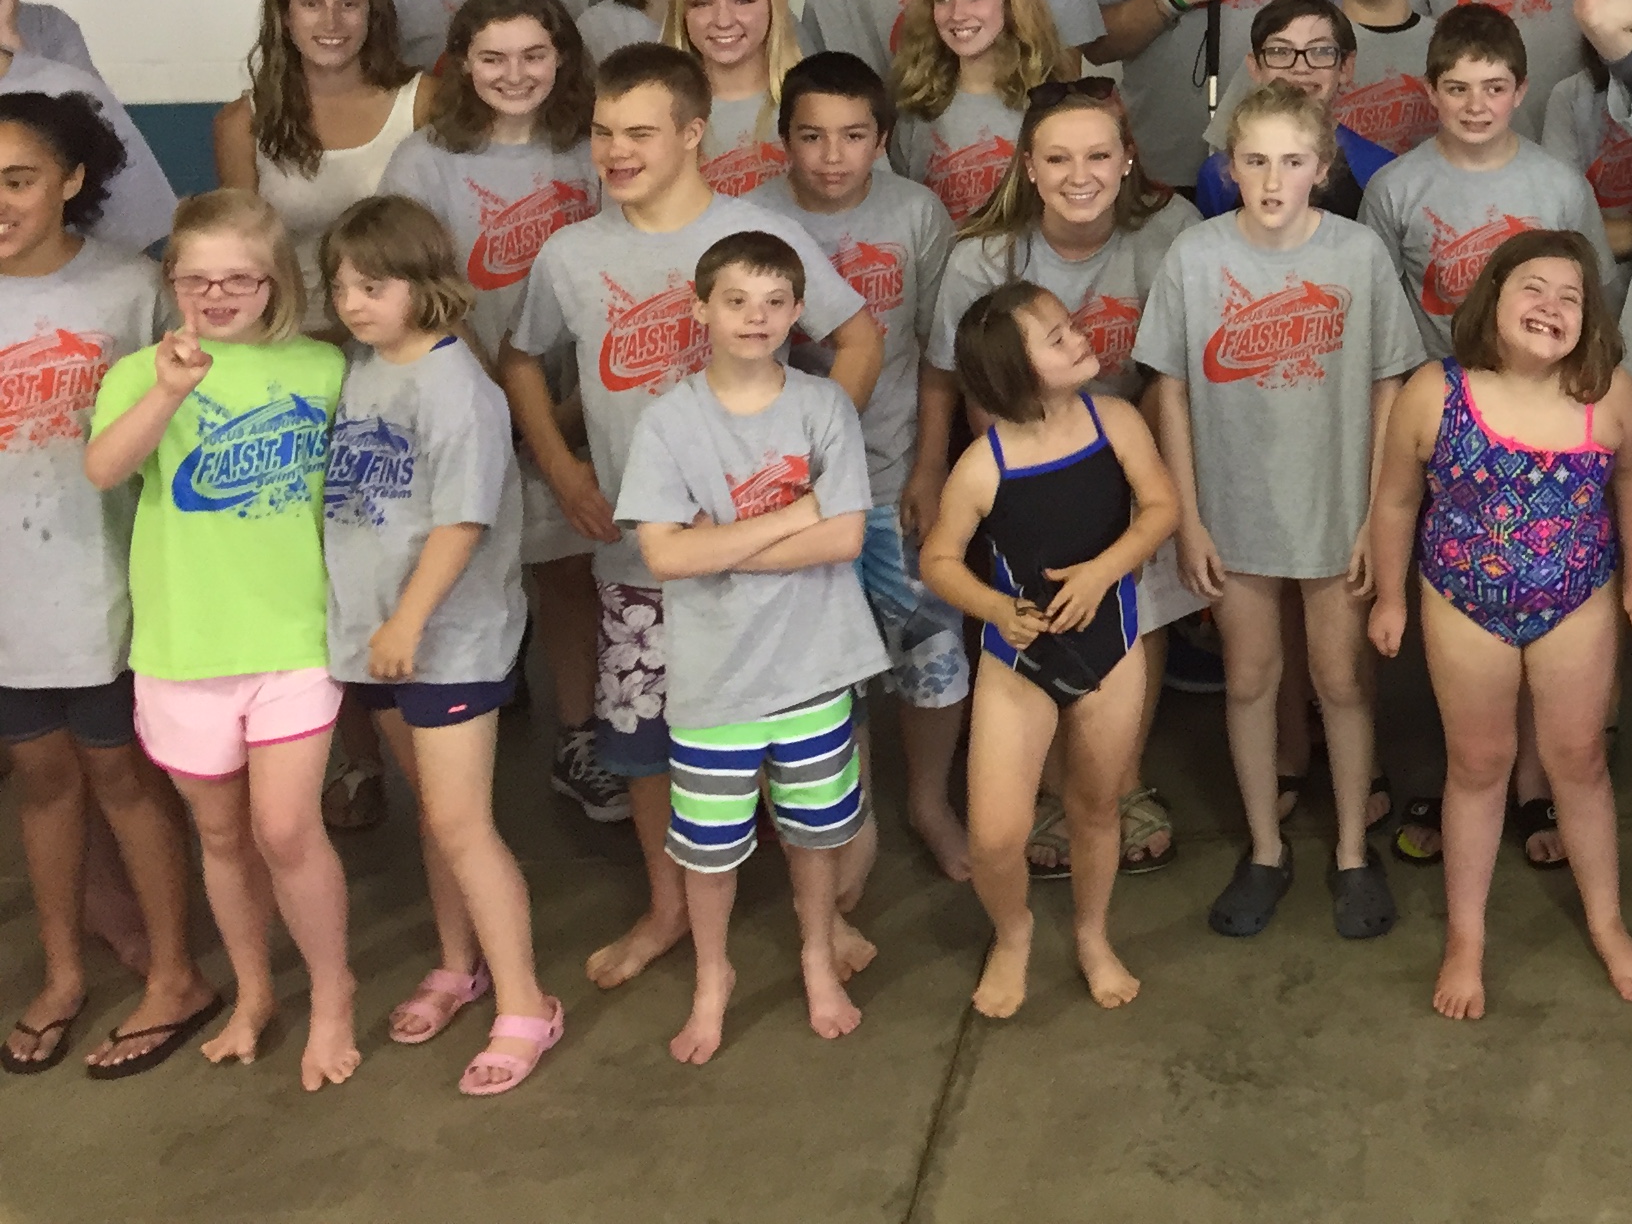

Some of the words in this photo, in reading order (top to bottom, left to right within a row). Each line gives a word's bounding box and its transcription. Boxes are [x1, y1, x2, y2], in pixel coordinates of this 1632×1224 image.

[1221, 321, 1293, 359] F.A.S.T.
[1302, 312, 1345, 344] FINS
[364, 456, 415, 486] FINS
